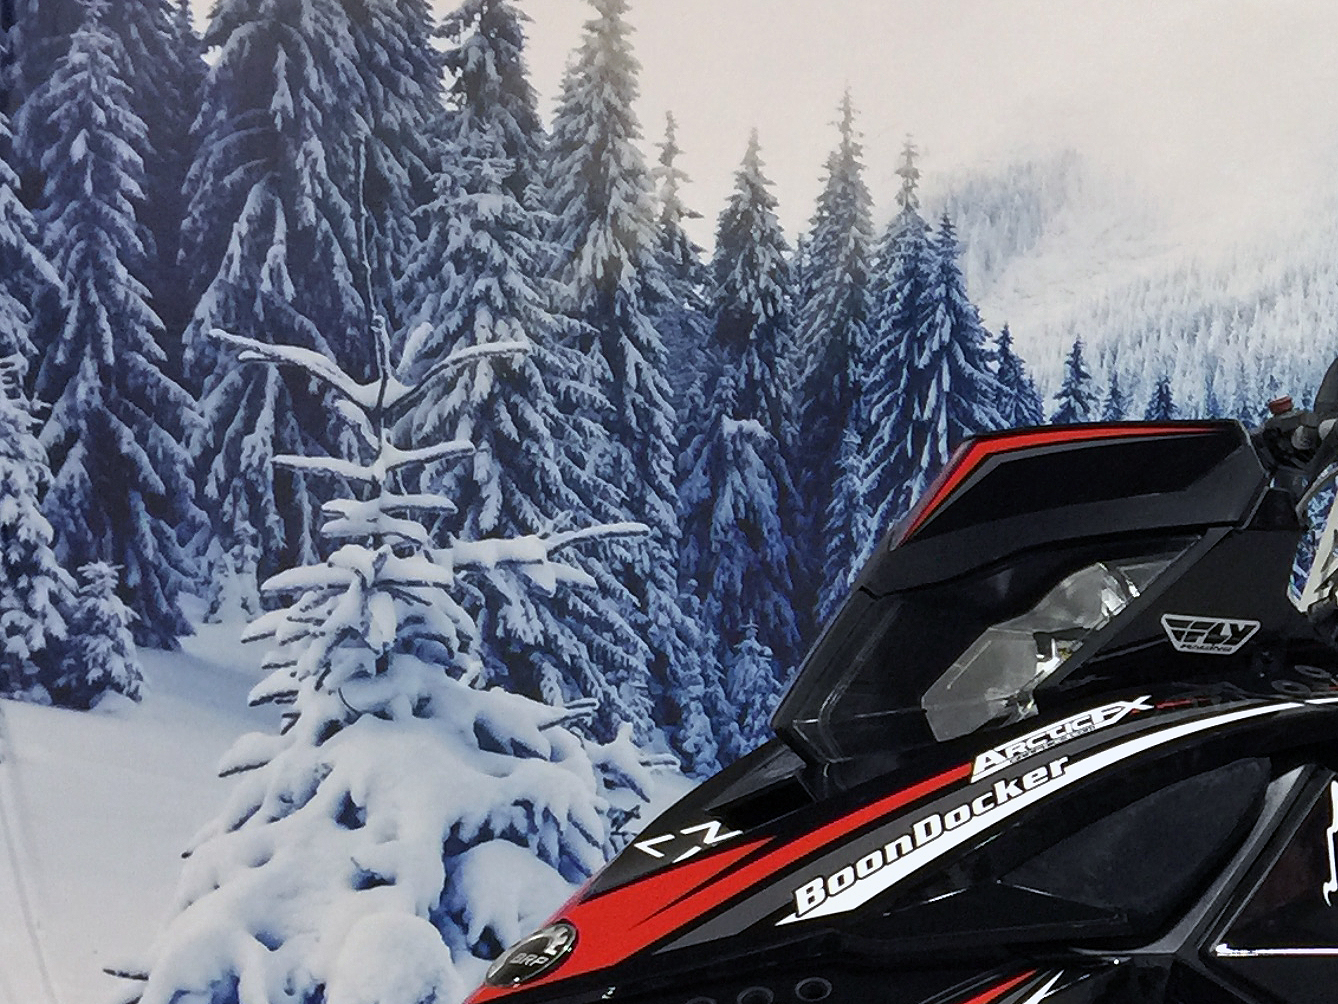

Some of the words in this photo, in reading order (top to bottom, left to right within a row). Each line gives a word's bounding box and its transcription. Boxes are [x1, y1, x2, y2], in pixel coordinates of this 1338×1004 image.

[1165, 618, 1258, 645] FLY
[793, 756, 1069, 918] BoonDocker
[509, 952, 550, 967] BRP
